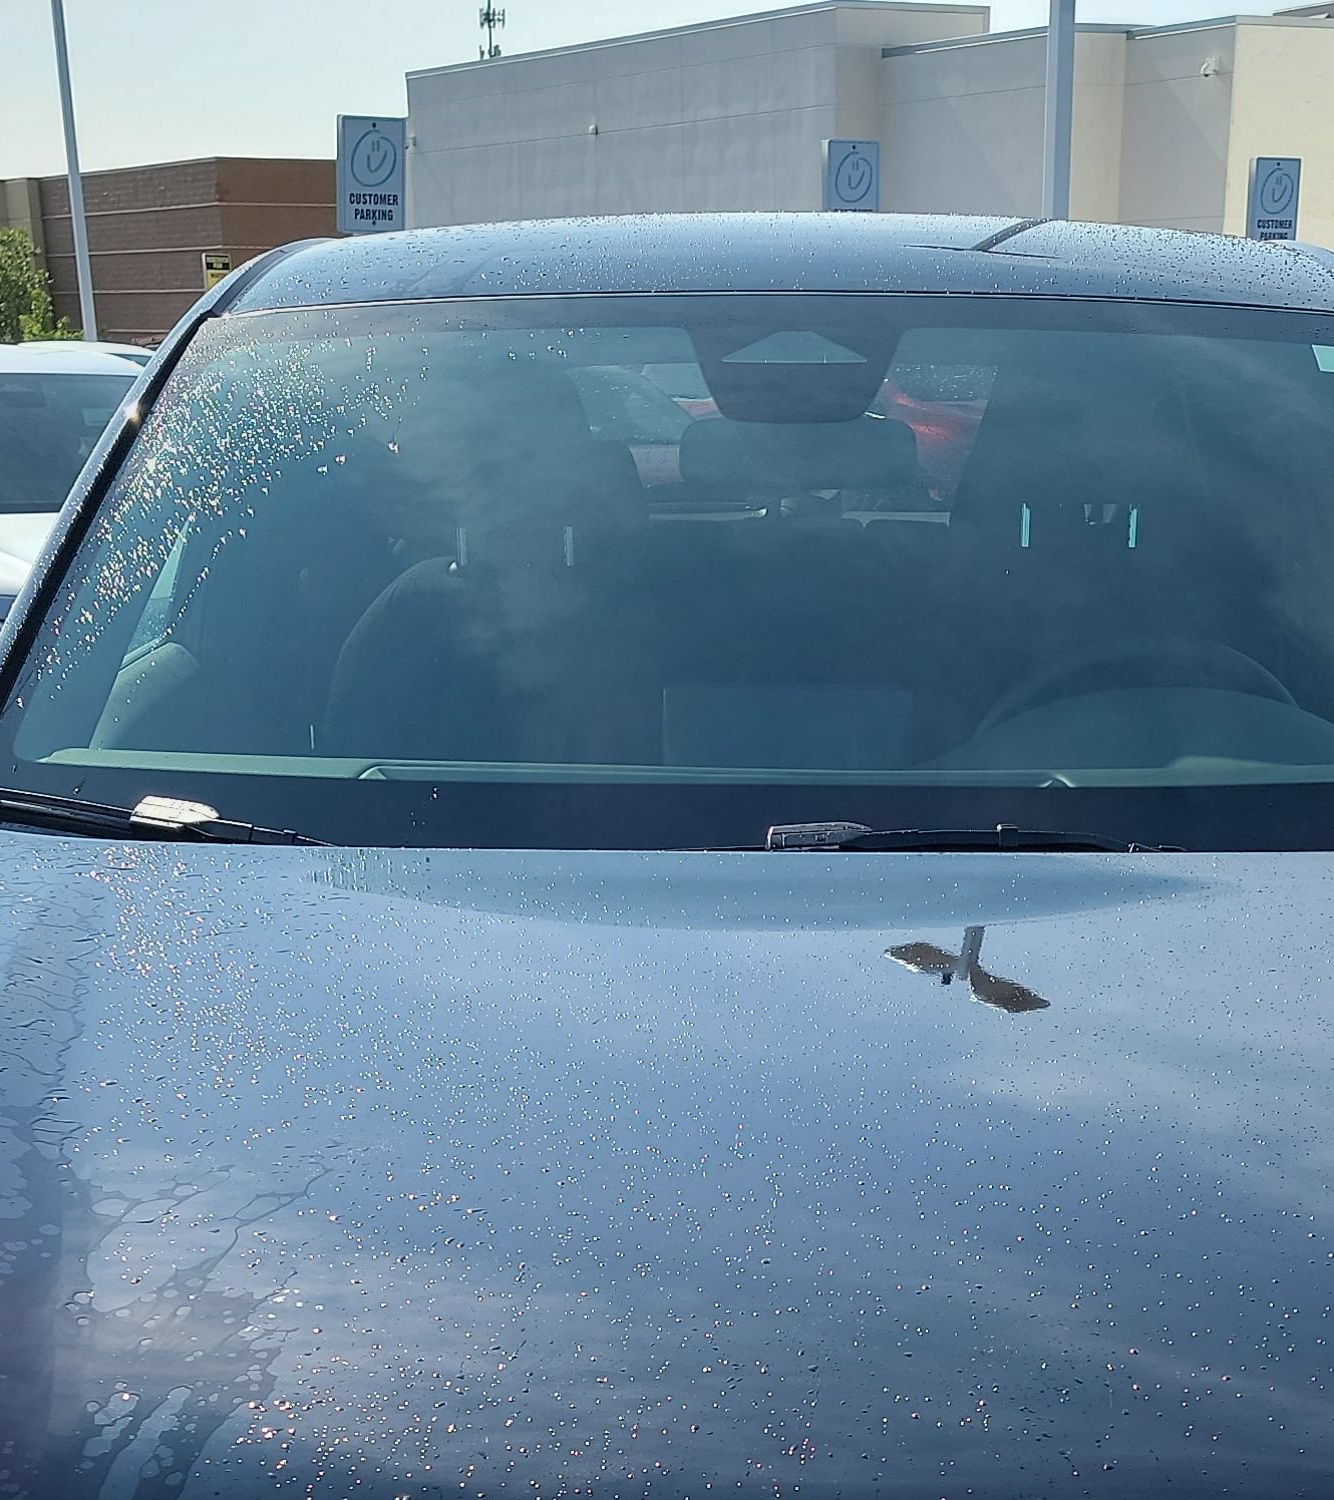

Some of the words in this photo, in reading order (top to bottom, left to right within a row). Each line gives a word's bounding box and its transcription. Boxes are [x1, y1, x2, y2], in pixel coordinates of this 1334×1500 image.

[349, 192, 398, 206] CUSTOMER
[354, 208, 394, 221] PARKING
[1257, 219, 1292, 229] CUSTOMER
